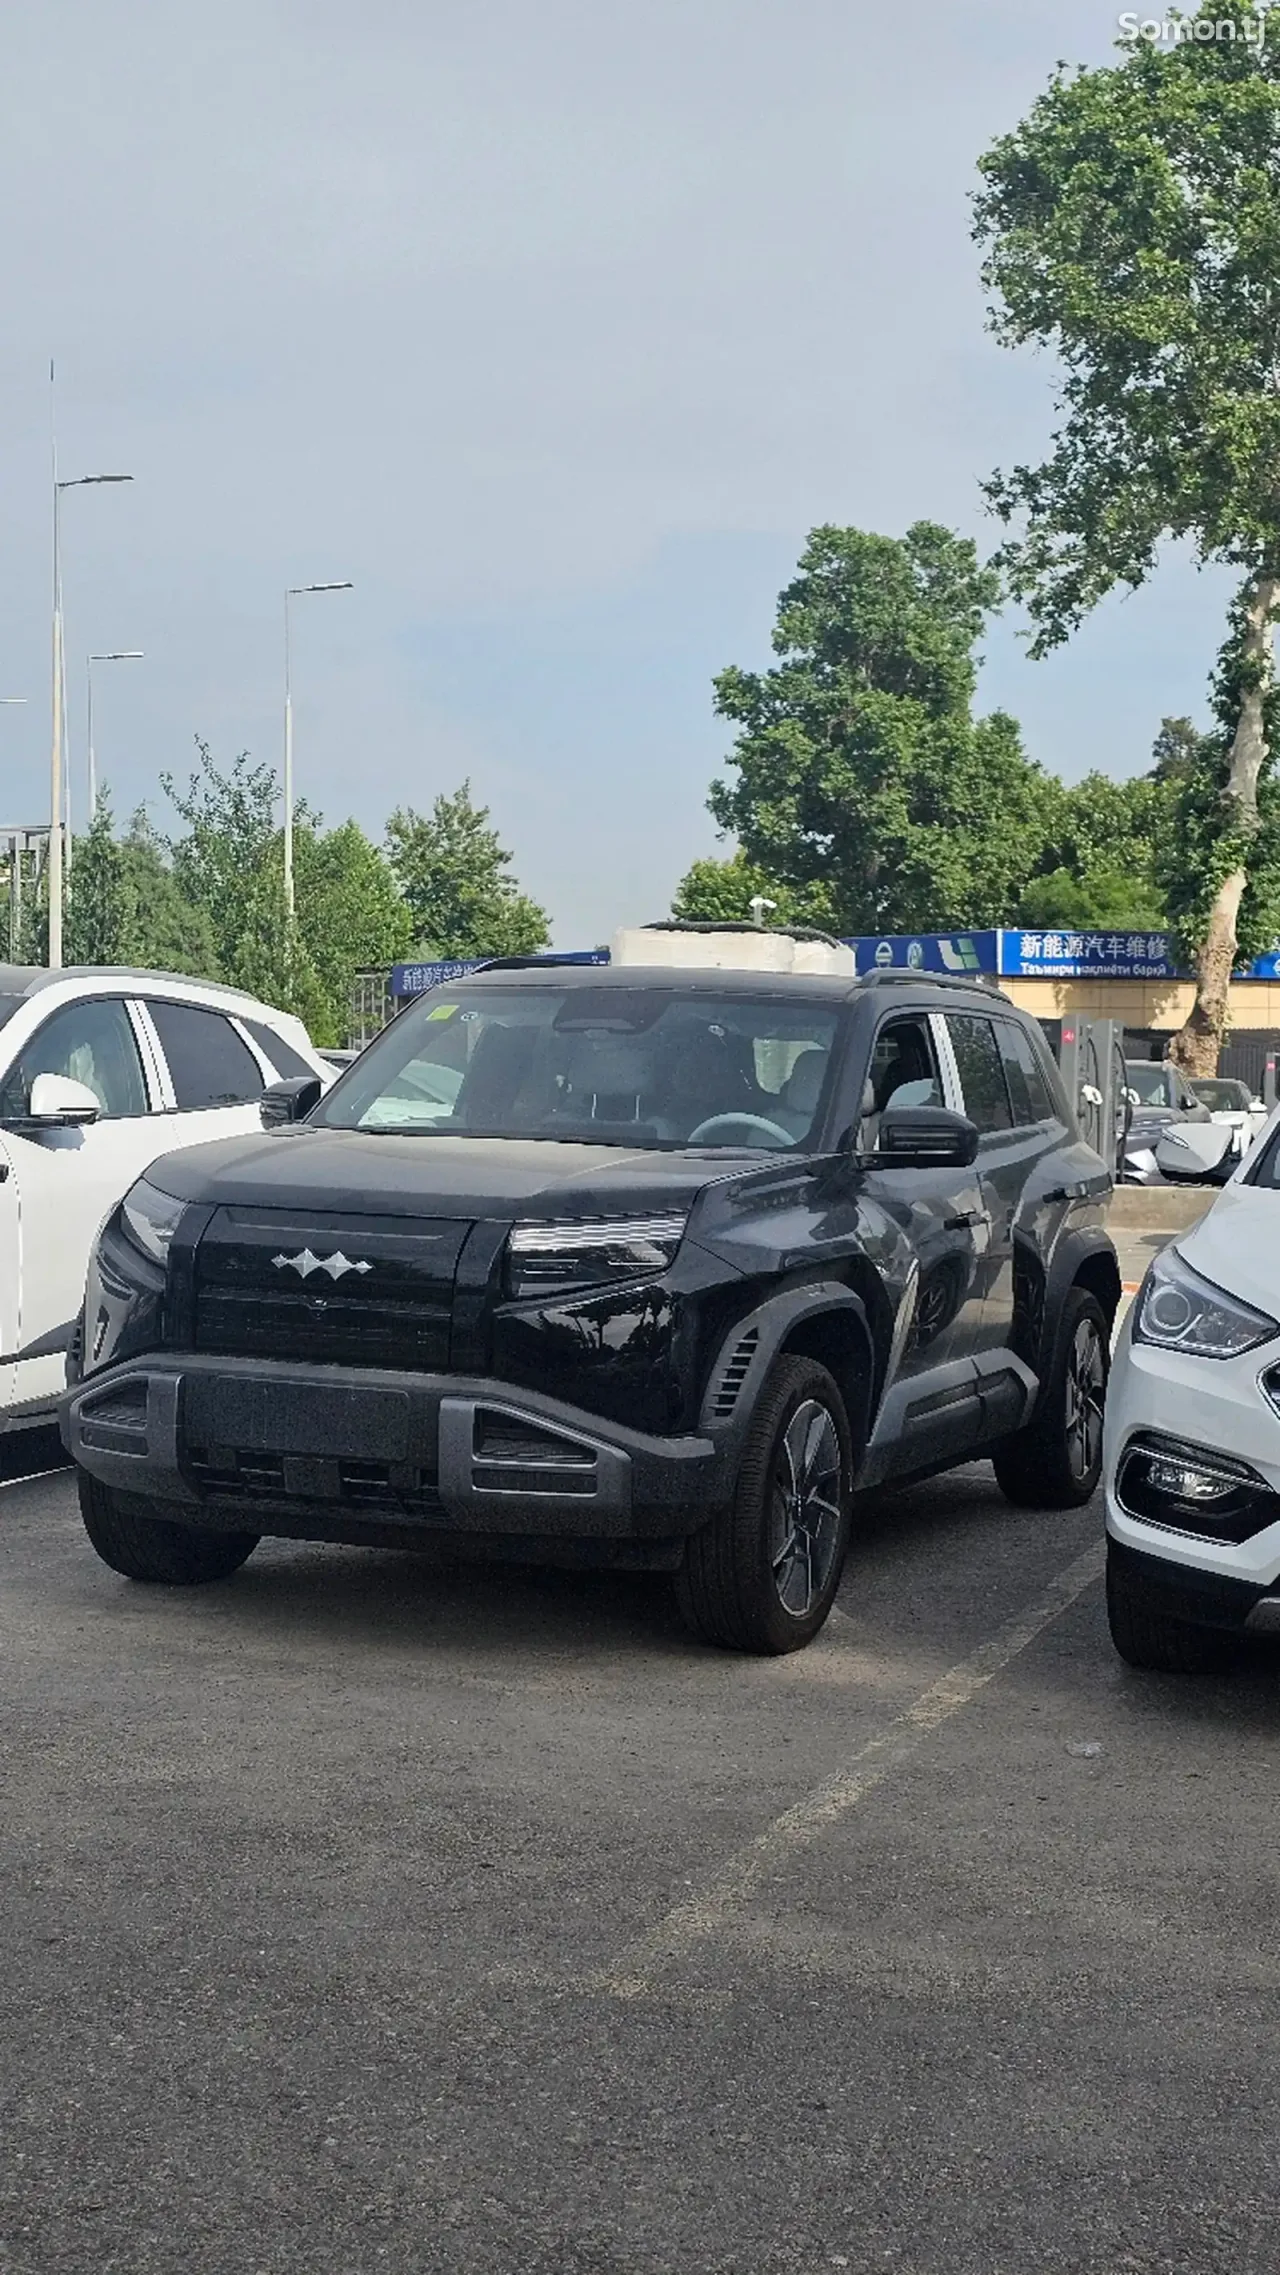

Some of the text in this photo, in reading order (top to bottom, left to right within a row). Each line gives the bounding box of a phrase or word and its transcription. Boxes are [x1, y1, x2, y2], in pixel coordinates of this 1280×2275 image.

[1020, 933, 1168, 959] 新能源汽车维修
